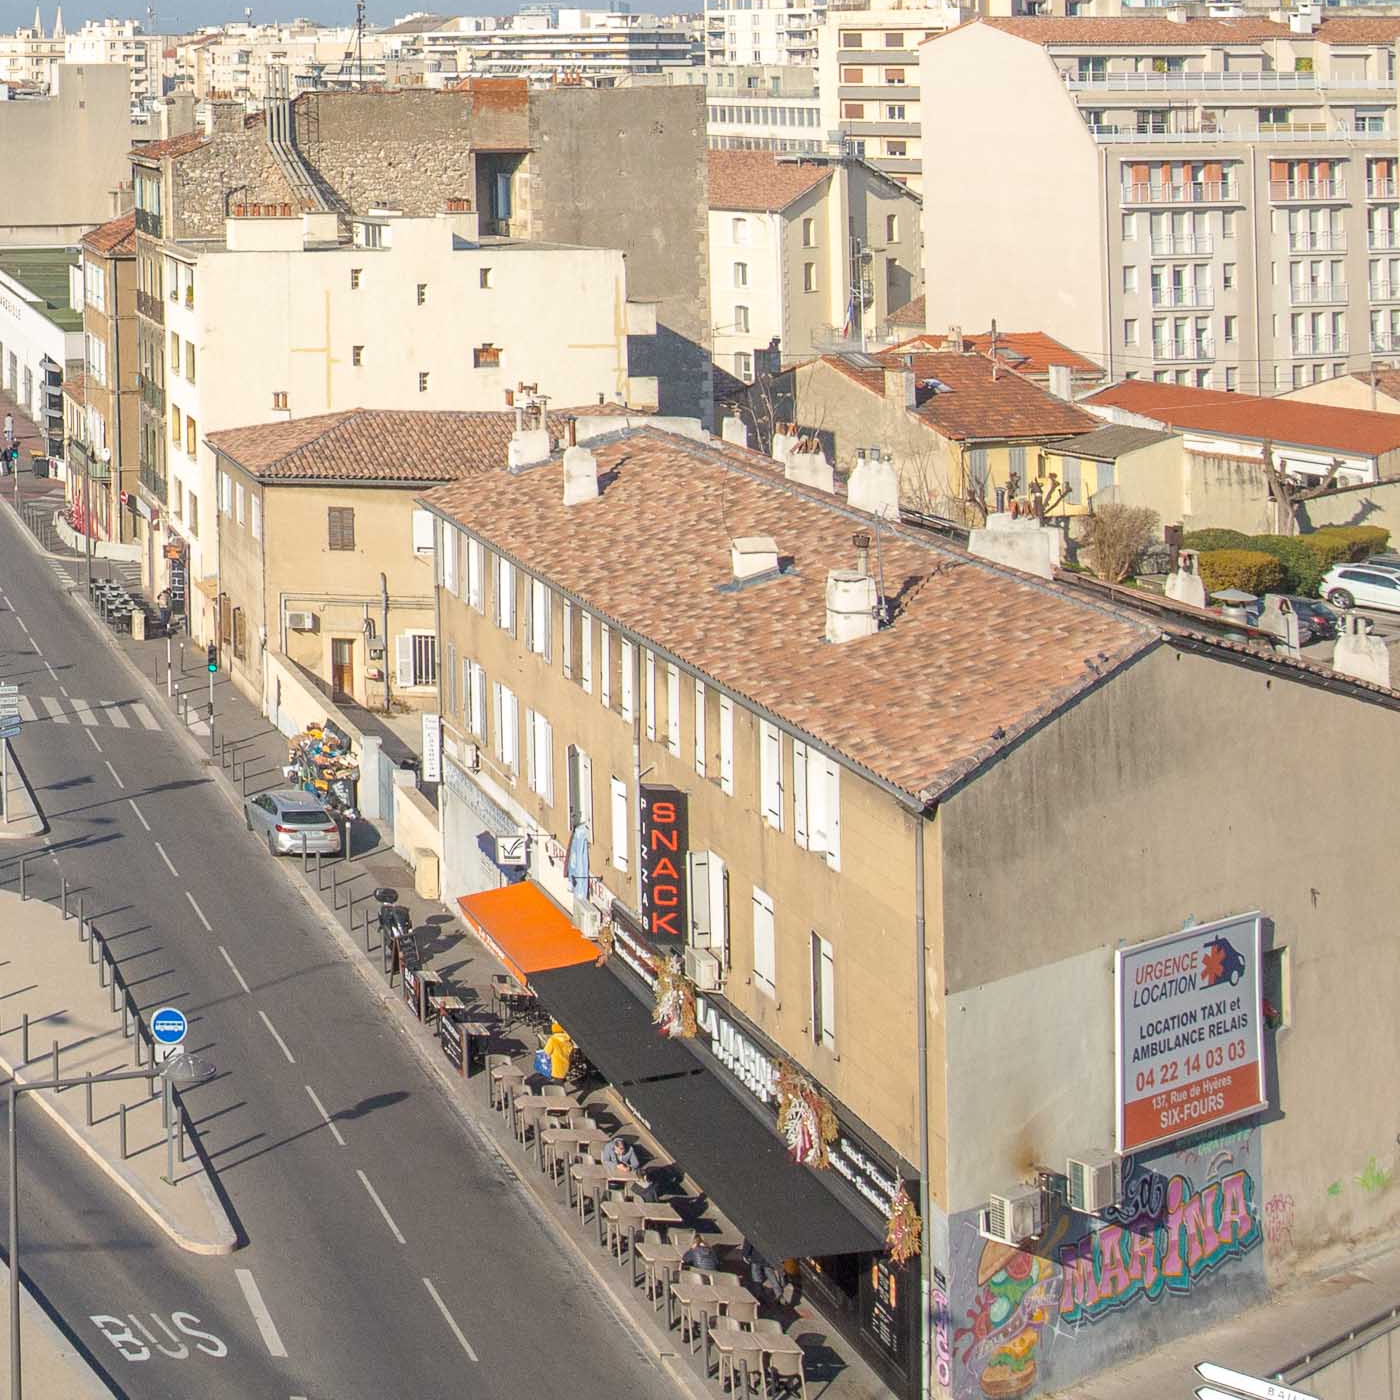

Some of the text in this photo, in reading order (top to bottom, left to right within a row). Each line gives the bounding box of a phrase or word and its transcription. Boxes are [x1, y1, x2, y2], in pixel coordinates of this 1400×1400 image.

[651, 802, 679, 935] SNACK
[1136, 951, 1198, 985] URGENCE
[1133, 972, 1197, 1008] LOCATION
[1132, 1013, 1248, 1063] AMBULANCE RELAIS
[1140, 996, 1240, 1039] LOCATION TAXI et
[1136, 1039, 1246, 1092] 04 22 14 03 03
[1152, 1075, 1232, 1111] 137, Rue de Hyères
[1160, 1092, 1224, 1129] SIX-FOURS
[89, 1311, 228, 1361] BUS
